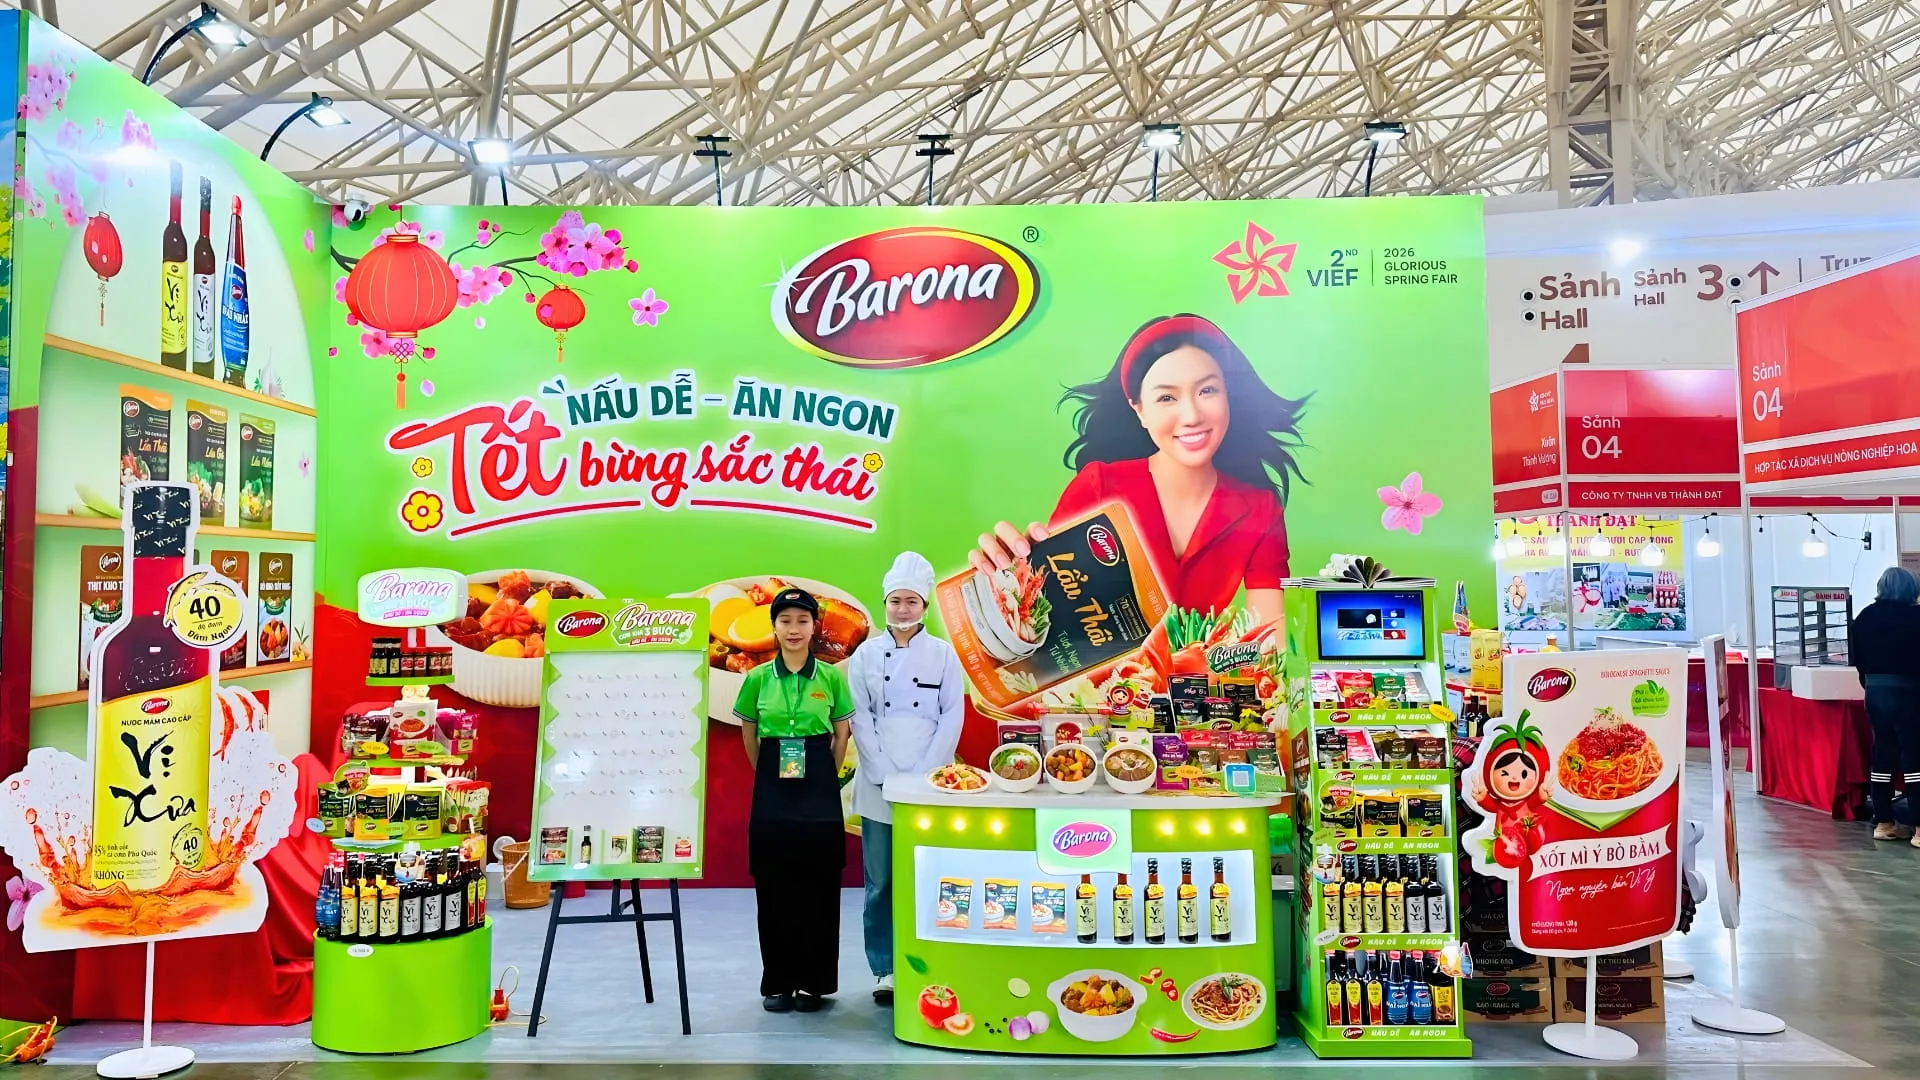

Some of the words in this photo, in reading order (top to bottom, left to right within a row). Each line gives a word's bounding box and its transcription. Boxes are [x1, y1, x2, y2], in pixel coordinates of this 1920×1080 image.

[1384, 248, 1415, 258] 2026
[1384, 260, 1447, 271] GLORIOUS
[1306, 268, 1358, 287] VIEF
[1384, 275, 1429, 285] SPRING
[1431, 273, 1458, 284] FAIR
[1539, 271, 1621, 300] Sảnh
[1634, 268, 1686, 288] Sảnh
[795, 258, 1003, 336] Barona
[1634, 292, 1665, 307] Hall
[1540, 308, 1588, 330] Hall
[1752, 361, 1781, 381] Sảnh
[566, 378, 640, 426] NẤU
[650, 374, 693, 416] DỄ
[733, 380, 781, 418] ĂN
[792, 390, 894, 438] NGON
[1753, 387, 1783, 421] 04
[1582, 414, 1621, 429] Sảnh
[389, 400, 567, 514] Tết
[1581, 435, 1622, 459] 04
[1754, 463, 1770, 475] HỢP
[1771, 459, 1787, 472] TÁC
[1800, 455, 1820, 470] DỊCH
[1834, 449, 1860, 463] NÔNG
[1861, 443, 1895, 460] NGHIỆP
[1896, 442, 1918, 455] HOA
[580, 441, 688, 507] bừng
[692, 435, 774, 484] sắc
[781, 446, 875, 501] thái
[1582, 490, 1610, 500] CÔNG
[1612, 492, 1625, 500] TY
[1626, 491, 1652, 499] TNHH
[1669, 489, 1702, 499] THÀNH
[1704, 490, 1723, 501] ĐẠT
[1092, 527, 1117, 562] Barona
[366, 573, 453, 603] Barona
[1046, 552, 1089, 600] Lẩu
[1074, 597, 1113, 647] Thái
[189, 595, 221, 619] 40
[560, 615, 602, 632] Barona
[614, 604, 695, 631] Barona
[1208, 644, 1258, 664] Barona
[1529, 675, 1569, 695] Barona
[183, 836, 198, 852] 40
[1055, 829, 1109, 850] Barona
[1540, 846, 1566, 867] XỐT
[1570, 845, 1588, 865] MÌ
[1593, 844, 1602, 863] Ý
[1607, 842, 1625, 861] BÒ
